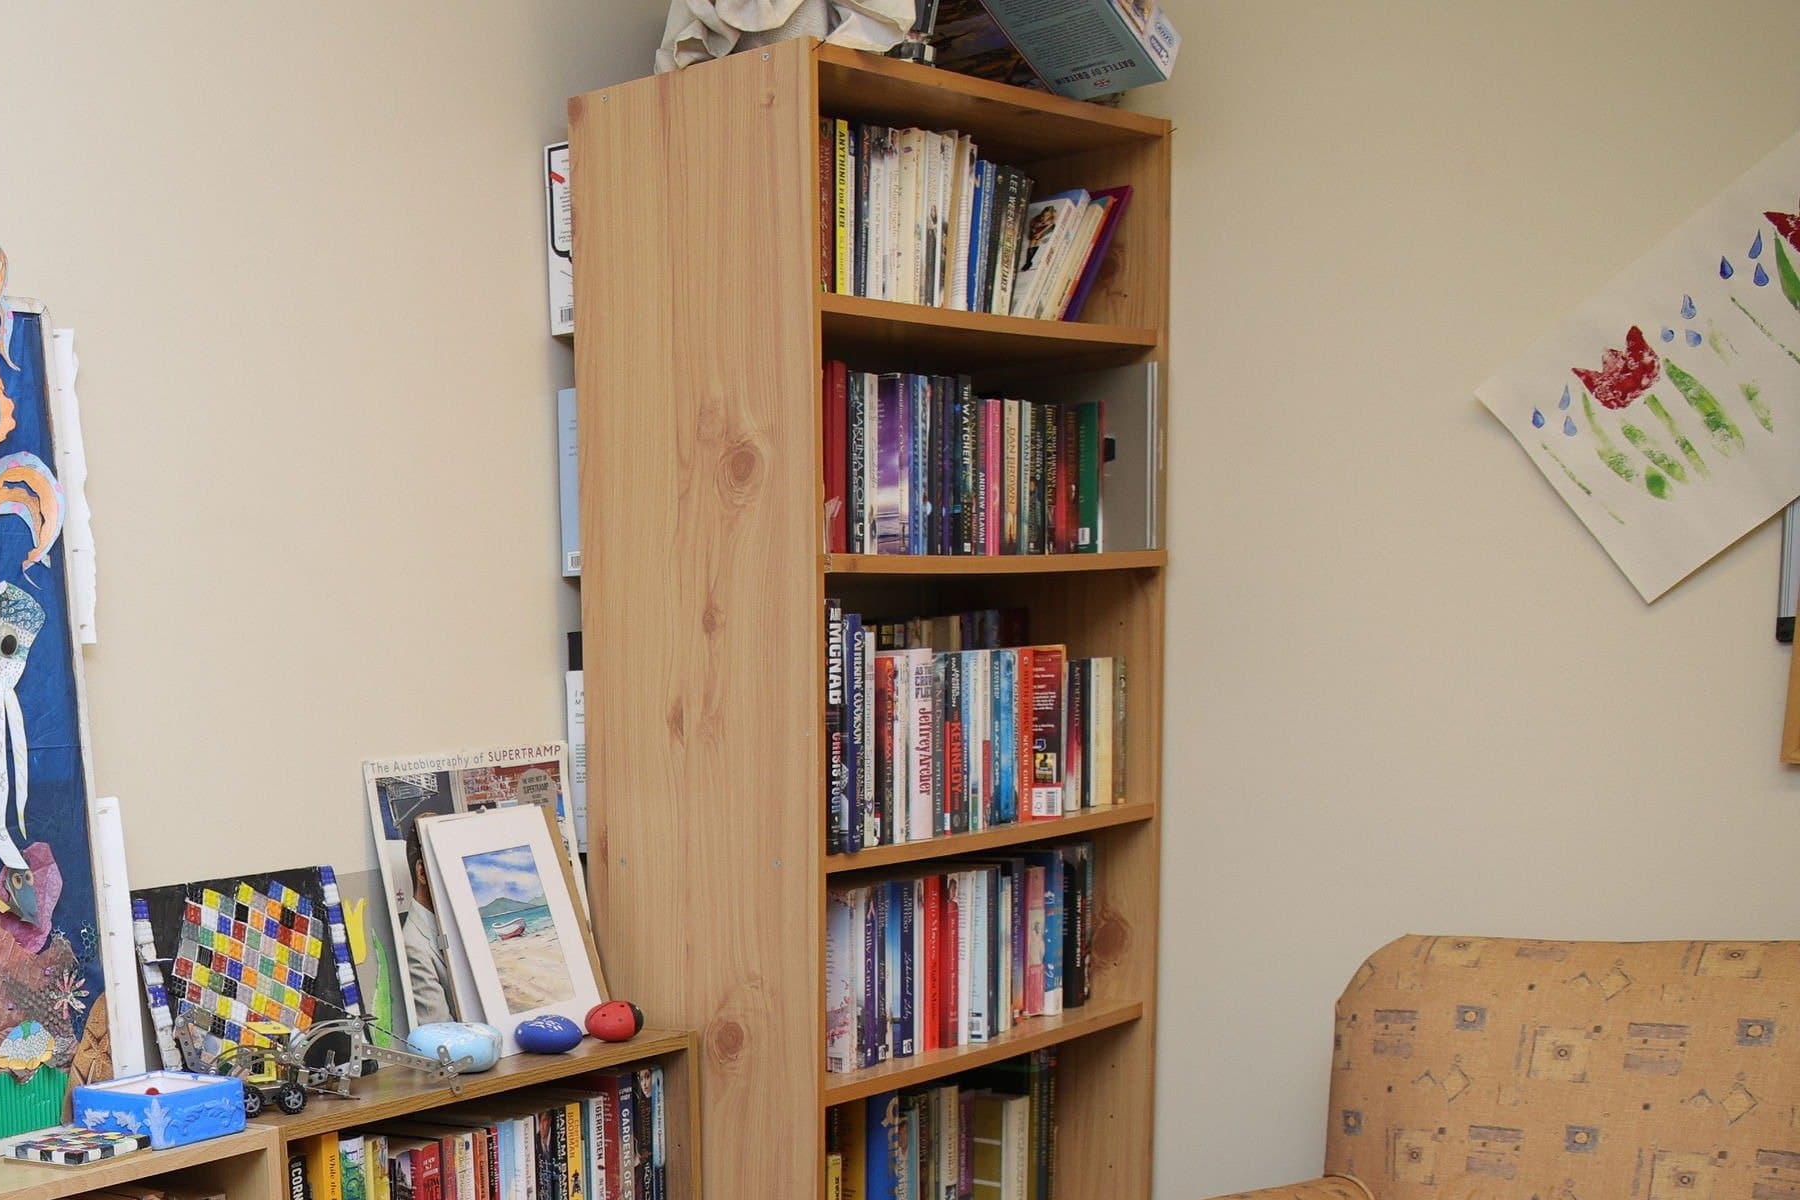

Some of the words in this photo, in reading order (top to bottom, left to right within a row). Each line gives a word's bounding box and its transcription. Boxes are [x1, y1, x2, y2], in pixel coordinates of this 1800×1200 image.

[371, 763, 389, 773] The
[393, 758, 469, 772] Autobiography
[474, 752, 484, 763] of
[488, 745, 560, 762] SUPERTRAMP
[621, 1109, 632, 1168] GARDENS
[624, 1170, 633, 1188] OF
